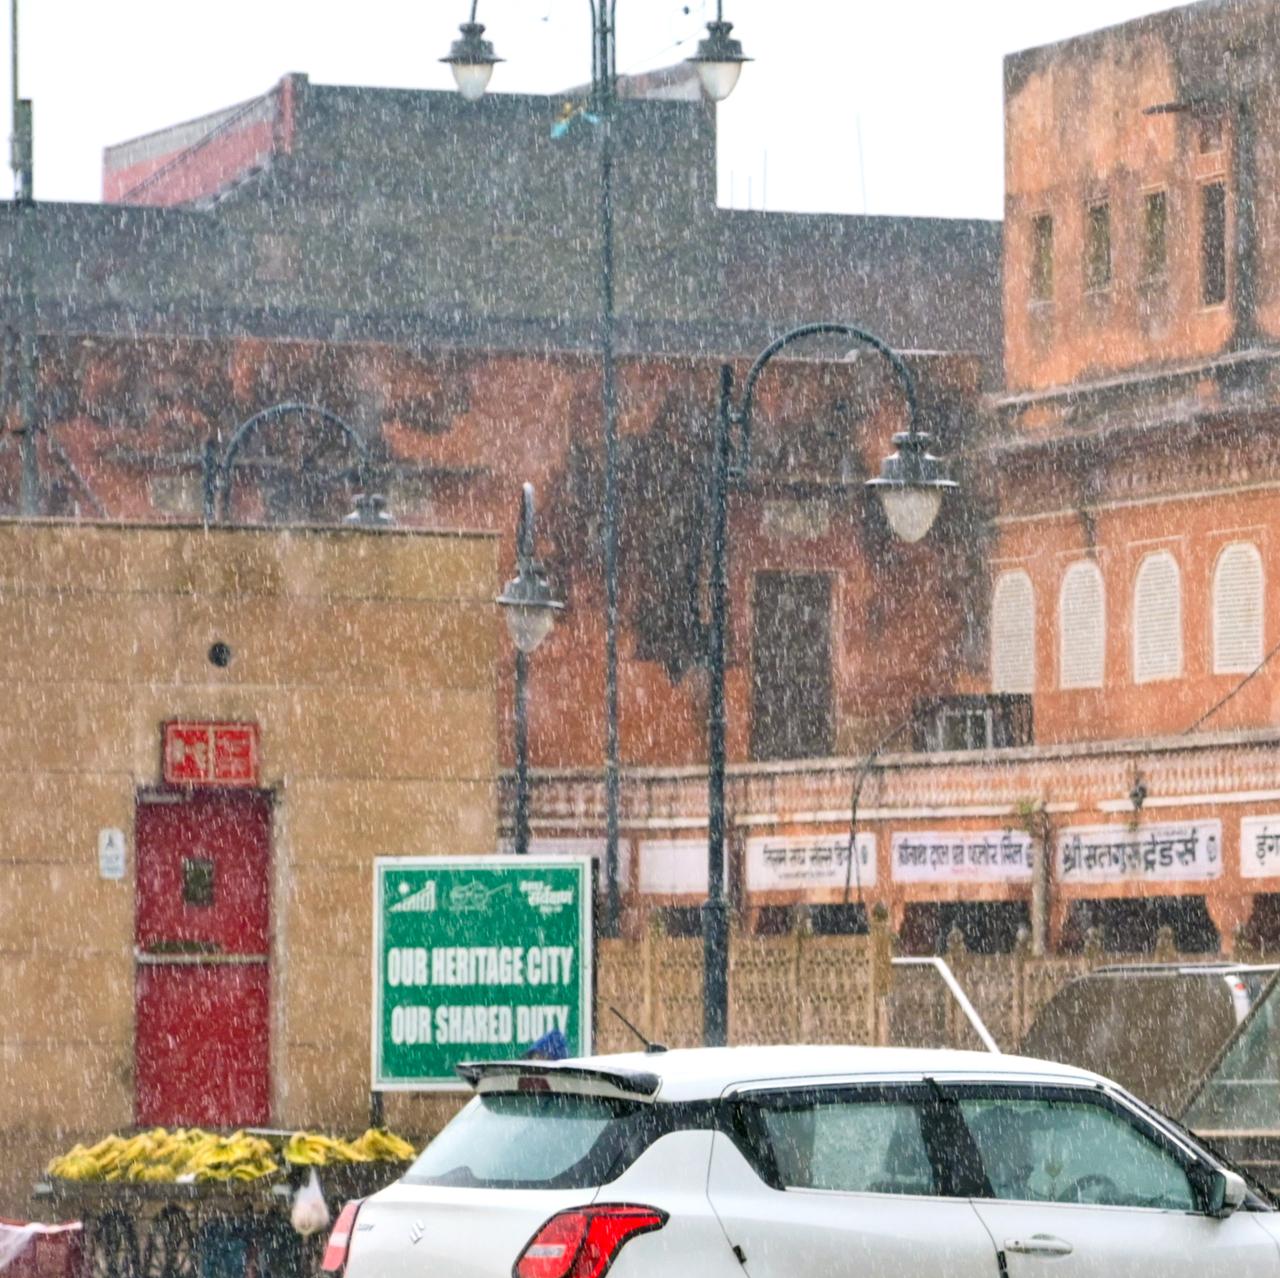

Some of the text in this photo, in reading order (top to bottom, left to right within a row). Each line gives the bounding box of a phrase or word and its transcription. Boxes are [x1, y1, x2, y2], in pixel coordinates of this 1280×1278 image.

[387, 946, 574, 986] OUR HERITAGE CITY
[392, 1005, 569, 1045] OUR SHARED DUTY
